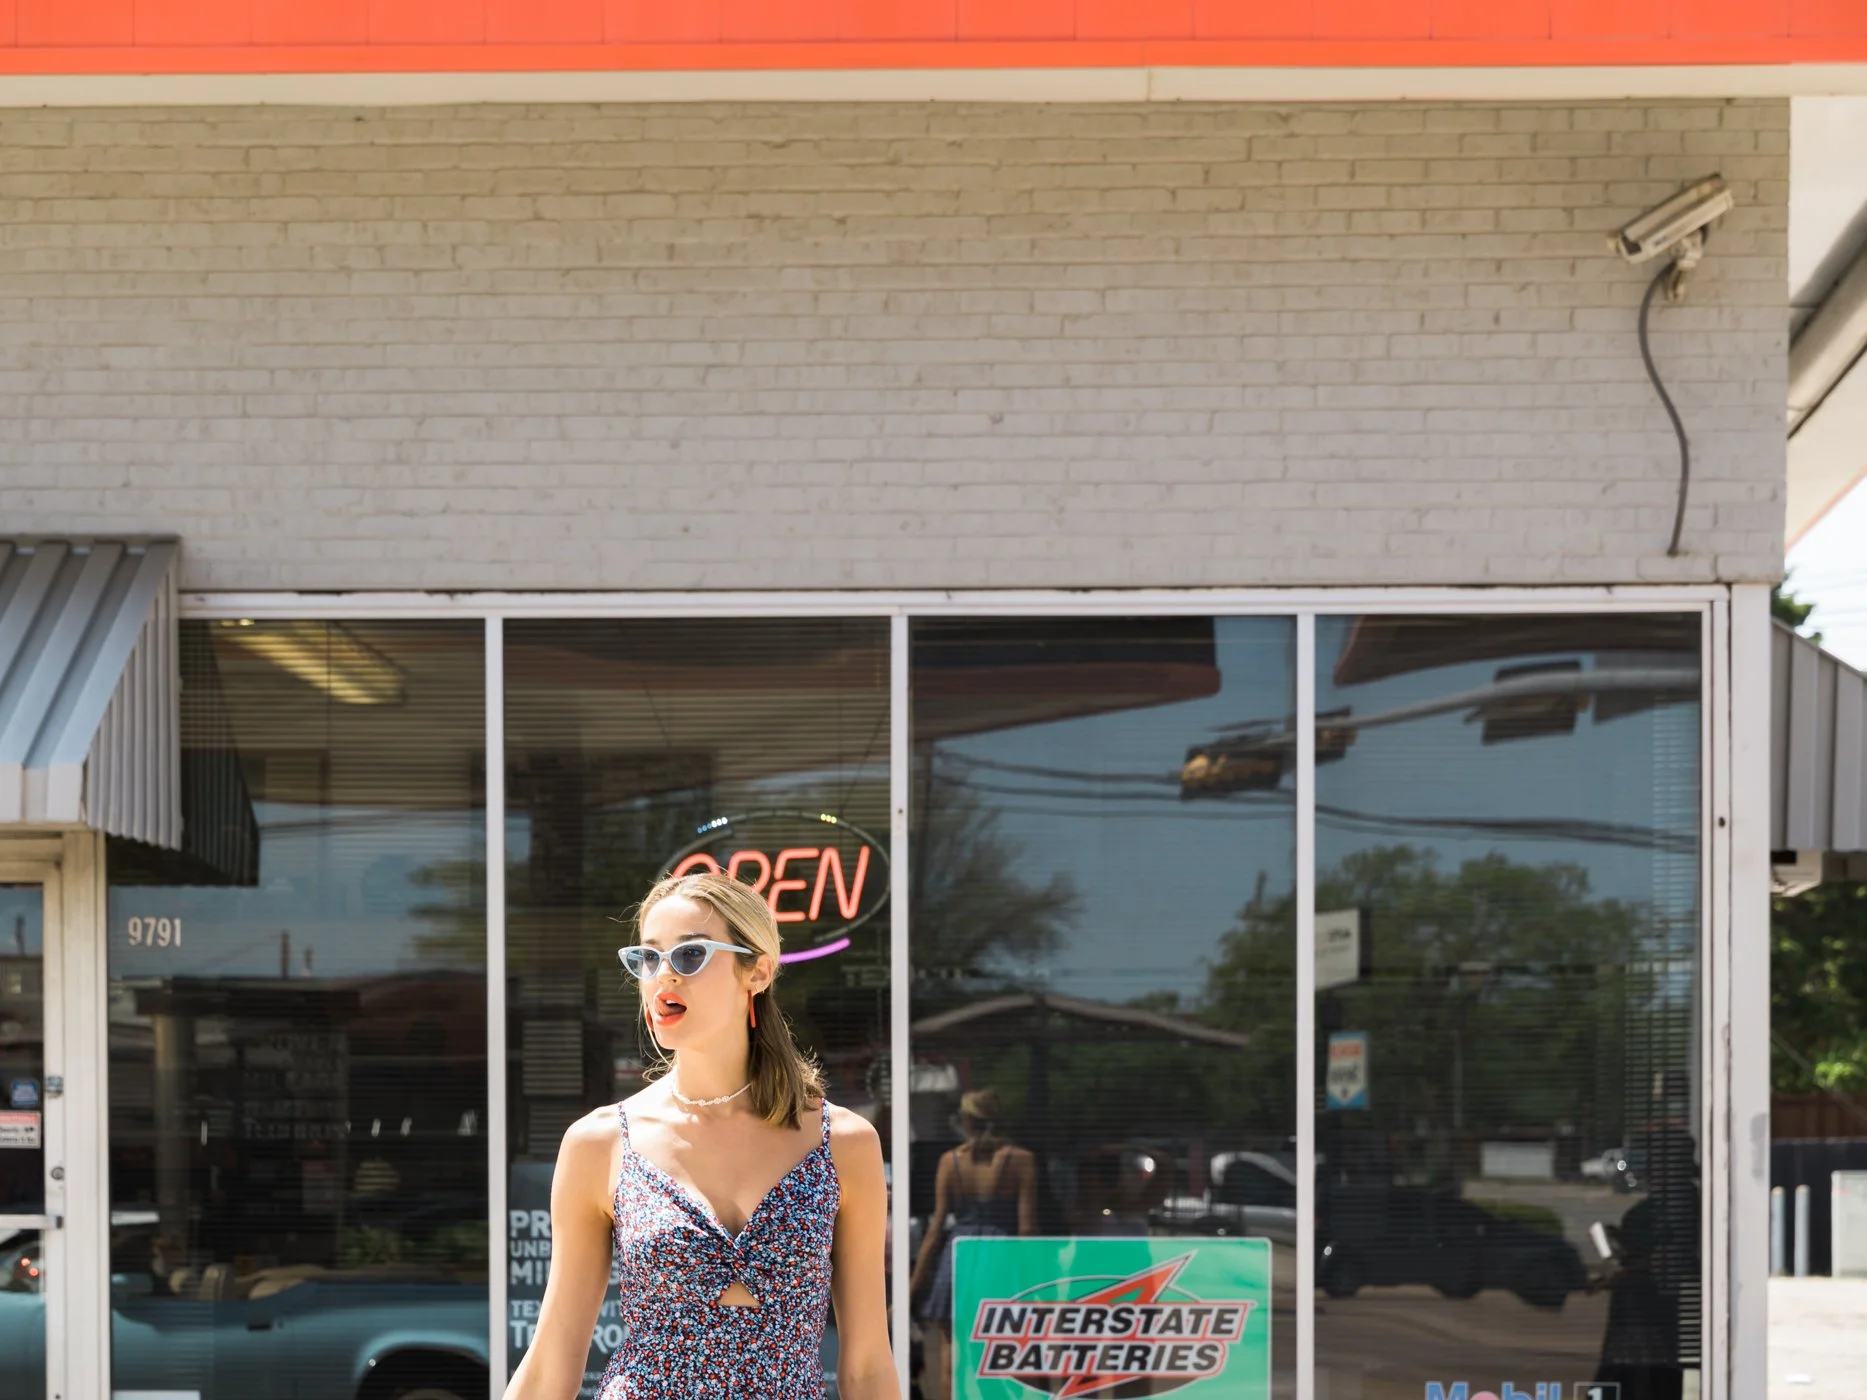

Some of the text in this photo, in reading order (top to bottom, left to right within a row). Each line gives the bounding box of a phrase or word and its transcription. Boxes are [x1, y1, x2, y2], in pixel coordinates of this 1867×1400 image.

[128, 917, 182, 947] 9791
[980, 1306, 1243, 1335] INTERSTATE
[987, 1342, 1222, 1372] BATTERIES
